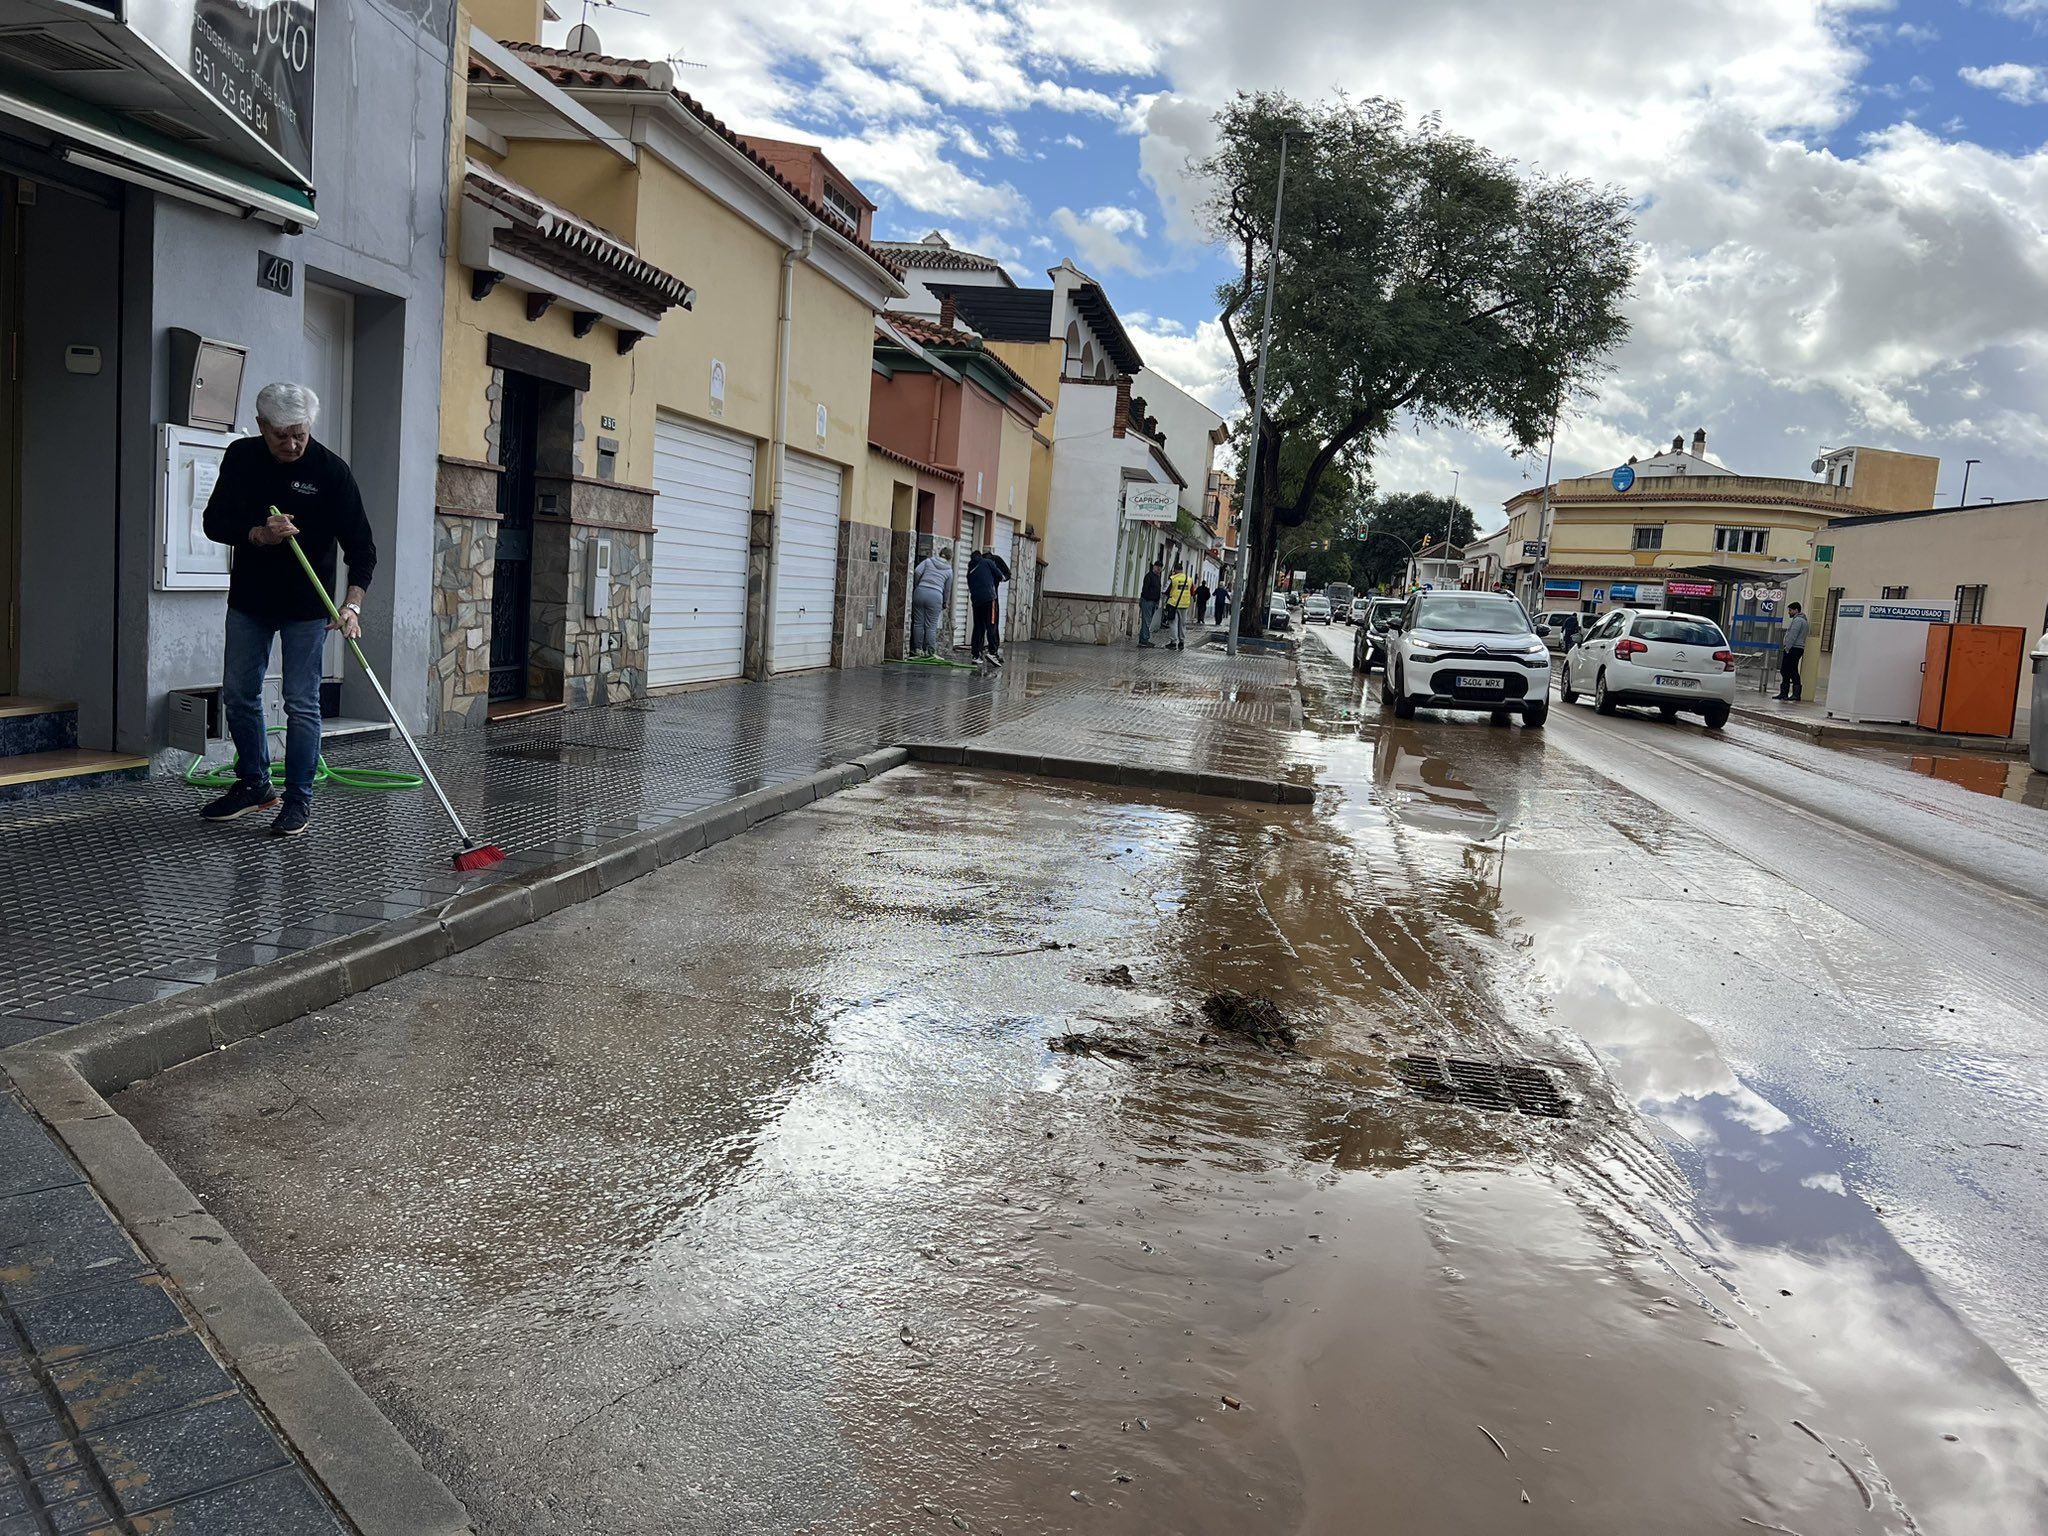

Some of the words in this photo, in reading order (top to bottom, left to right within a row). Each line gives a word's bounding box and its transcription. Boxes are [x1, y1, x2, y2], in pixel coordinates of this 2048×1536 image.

[251, 69, 272, 101] FOTOS
[195, 47, 216, 88] 951
[222, 72, 236, 105] 25
[240, 89, 252, 120] 68
[256, 104, 268, 135] 84
[268, 259, 290, 290] 40
[1743, 590, 1753, 599] 19
[1757, 590, 1768, 599] 25
[1770, 591, 1782, 600] 28
[1762, 602, 1774, 611] N3
[1870, 606, 1886, 614] ROPA
[1892, 607, 1920, 616] CALZADO
[1921, 609, 1942, 617] USADO
[1463, 678, 1482, 686] 5404
[1661, 678, 1679, 687] 2606
